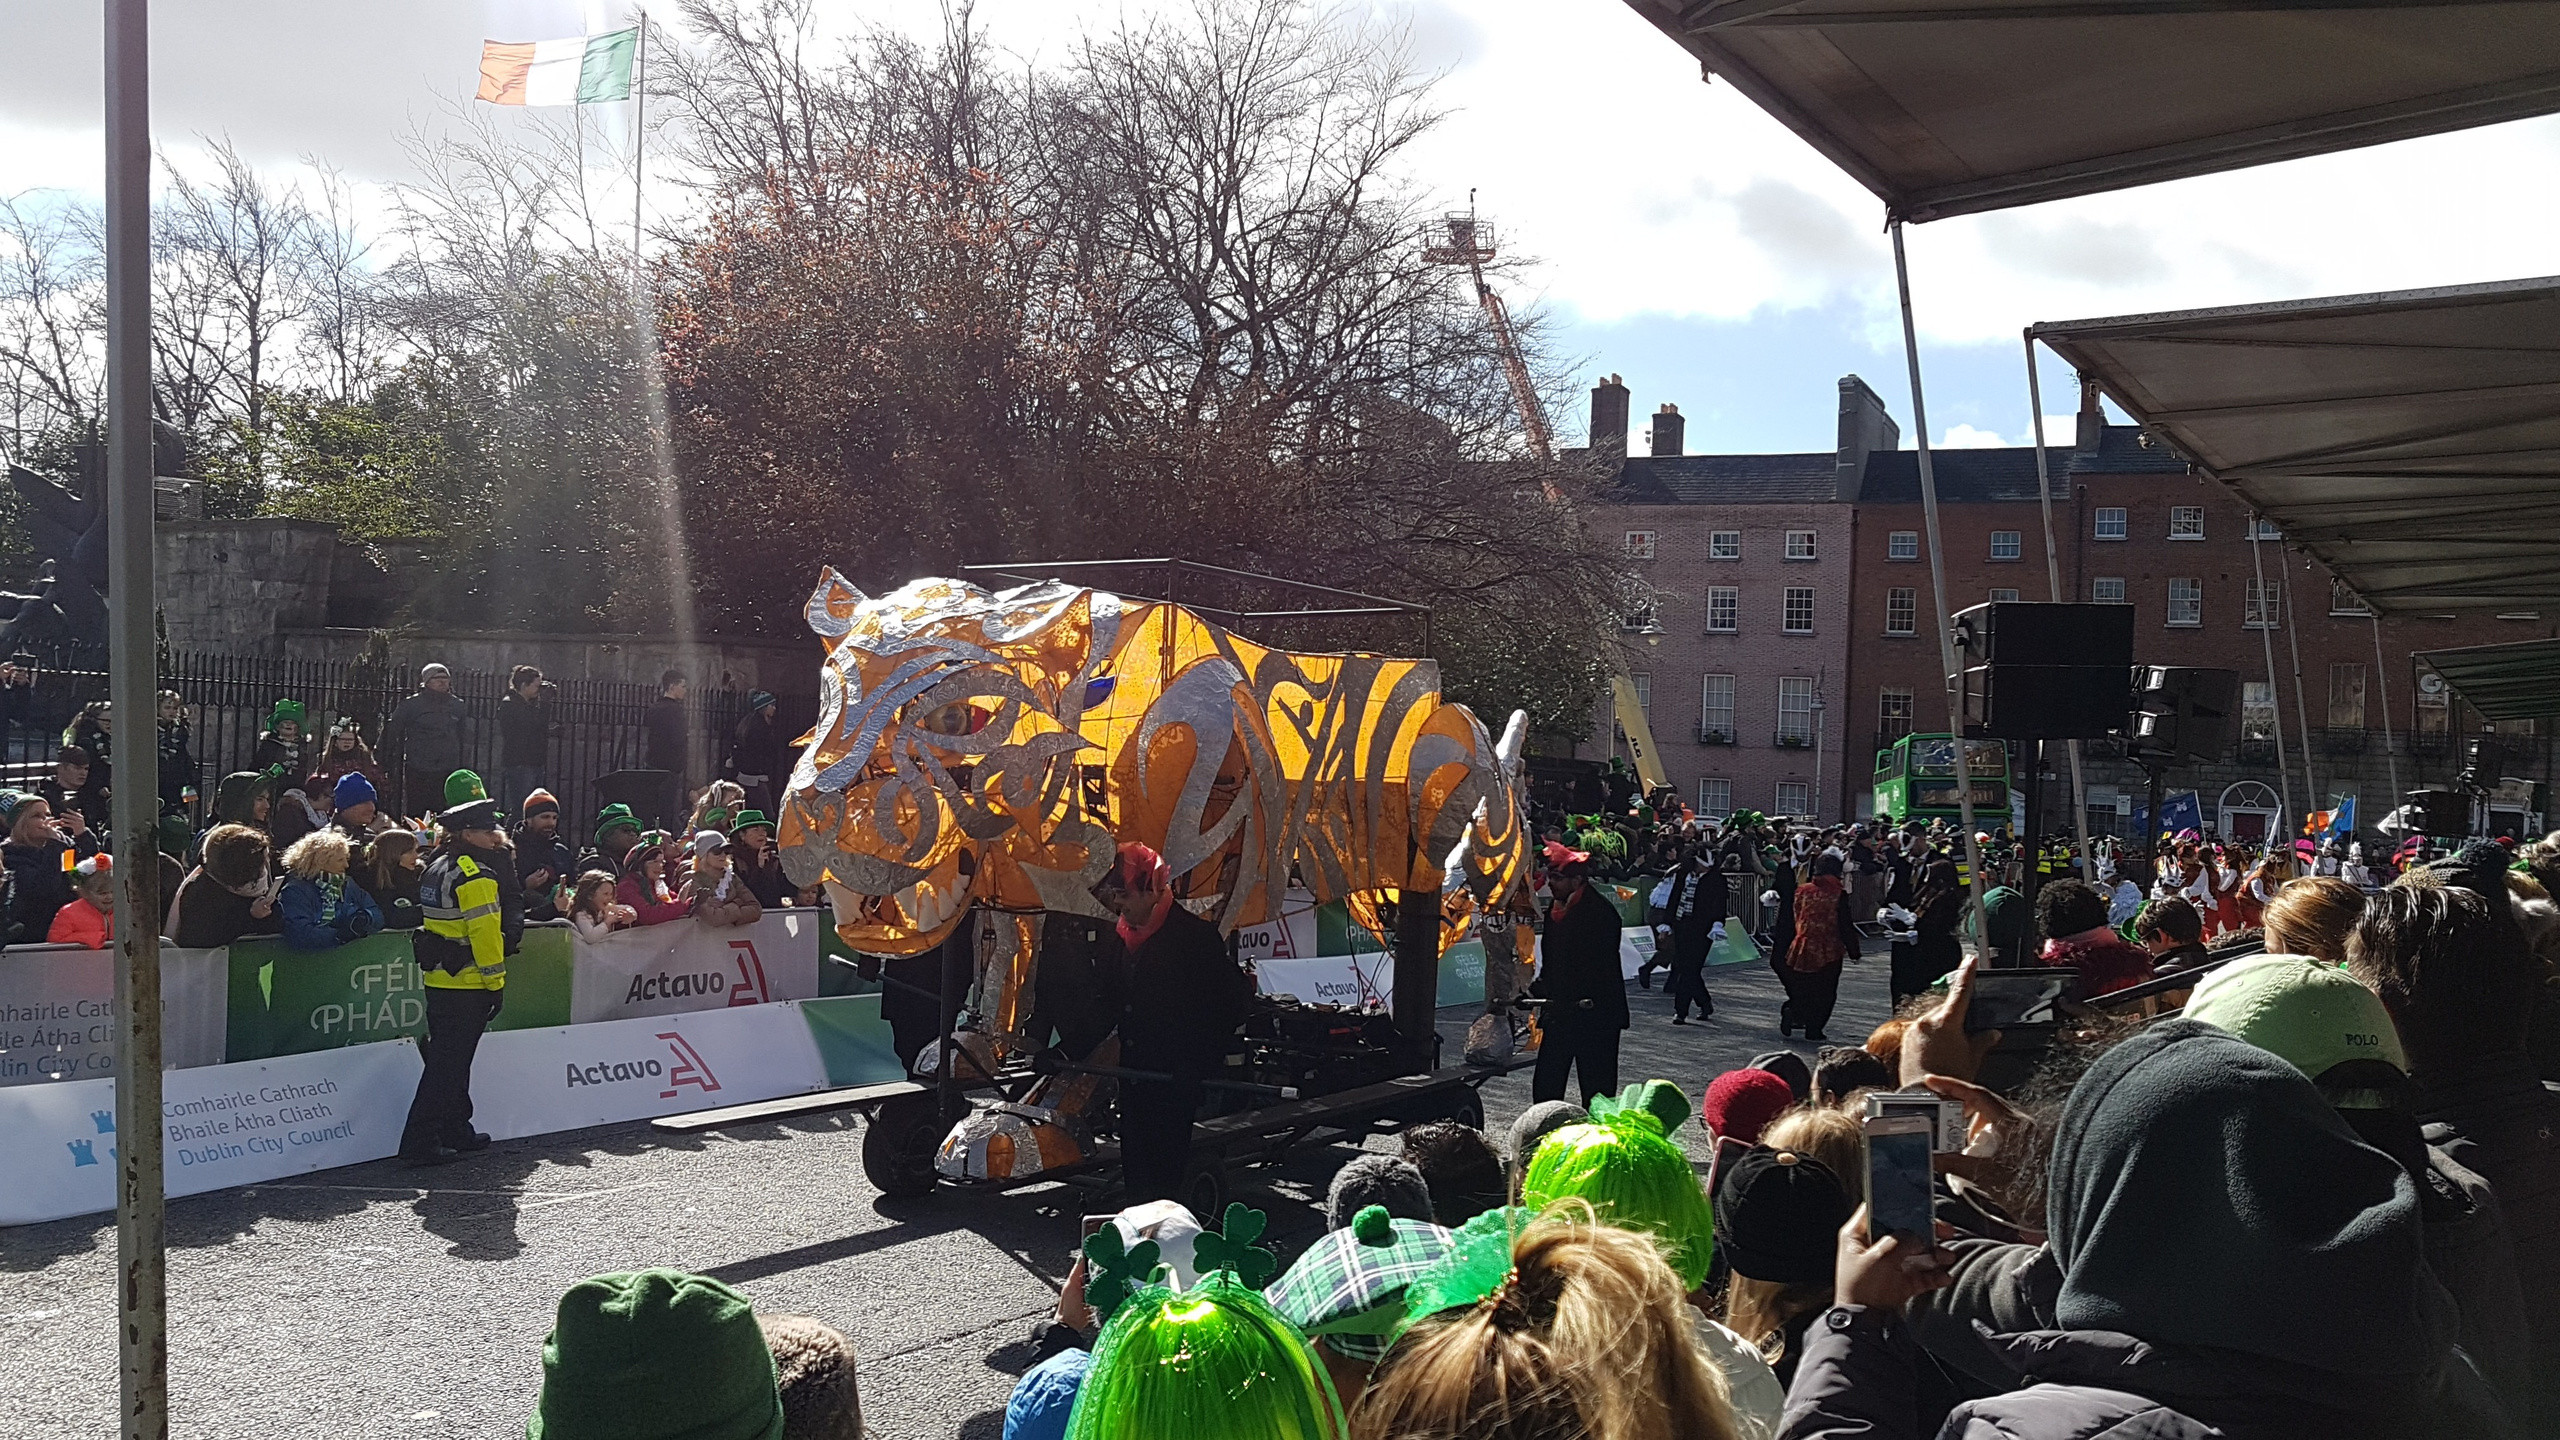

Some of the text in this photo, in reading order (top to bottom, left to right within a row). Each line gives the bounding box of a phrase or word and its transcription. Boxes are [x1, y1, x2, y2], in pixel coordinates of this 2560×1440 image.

[1239, 932, 1270, 949] avo
[625, 972, 724, 1004] Actavo
[1315, 981, 1357, 998] Actavo
[310, 993, 424, 1034] PHÁD
[31, 1026, 81, 1048] Átha
[2345, 1034, 2379, 1046] POLO
[2, 1059, 28, 1077] lin
[37, 1055, 79, 1078] City
[566, 1059, 662, 1088] Actavo
[162, 1078, 338, 1118] Comhairle Cathrach
[168, 1103, 333, 1142] Bhaile Átha Cliath
[178, 1120, 356, 1166] Dublin City Council
